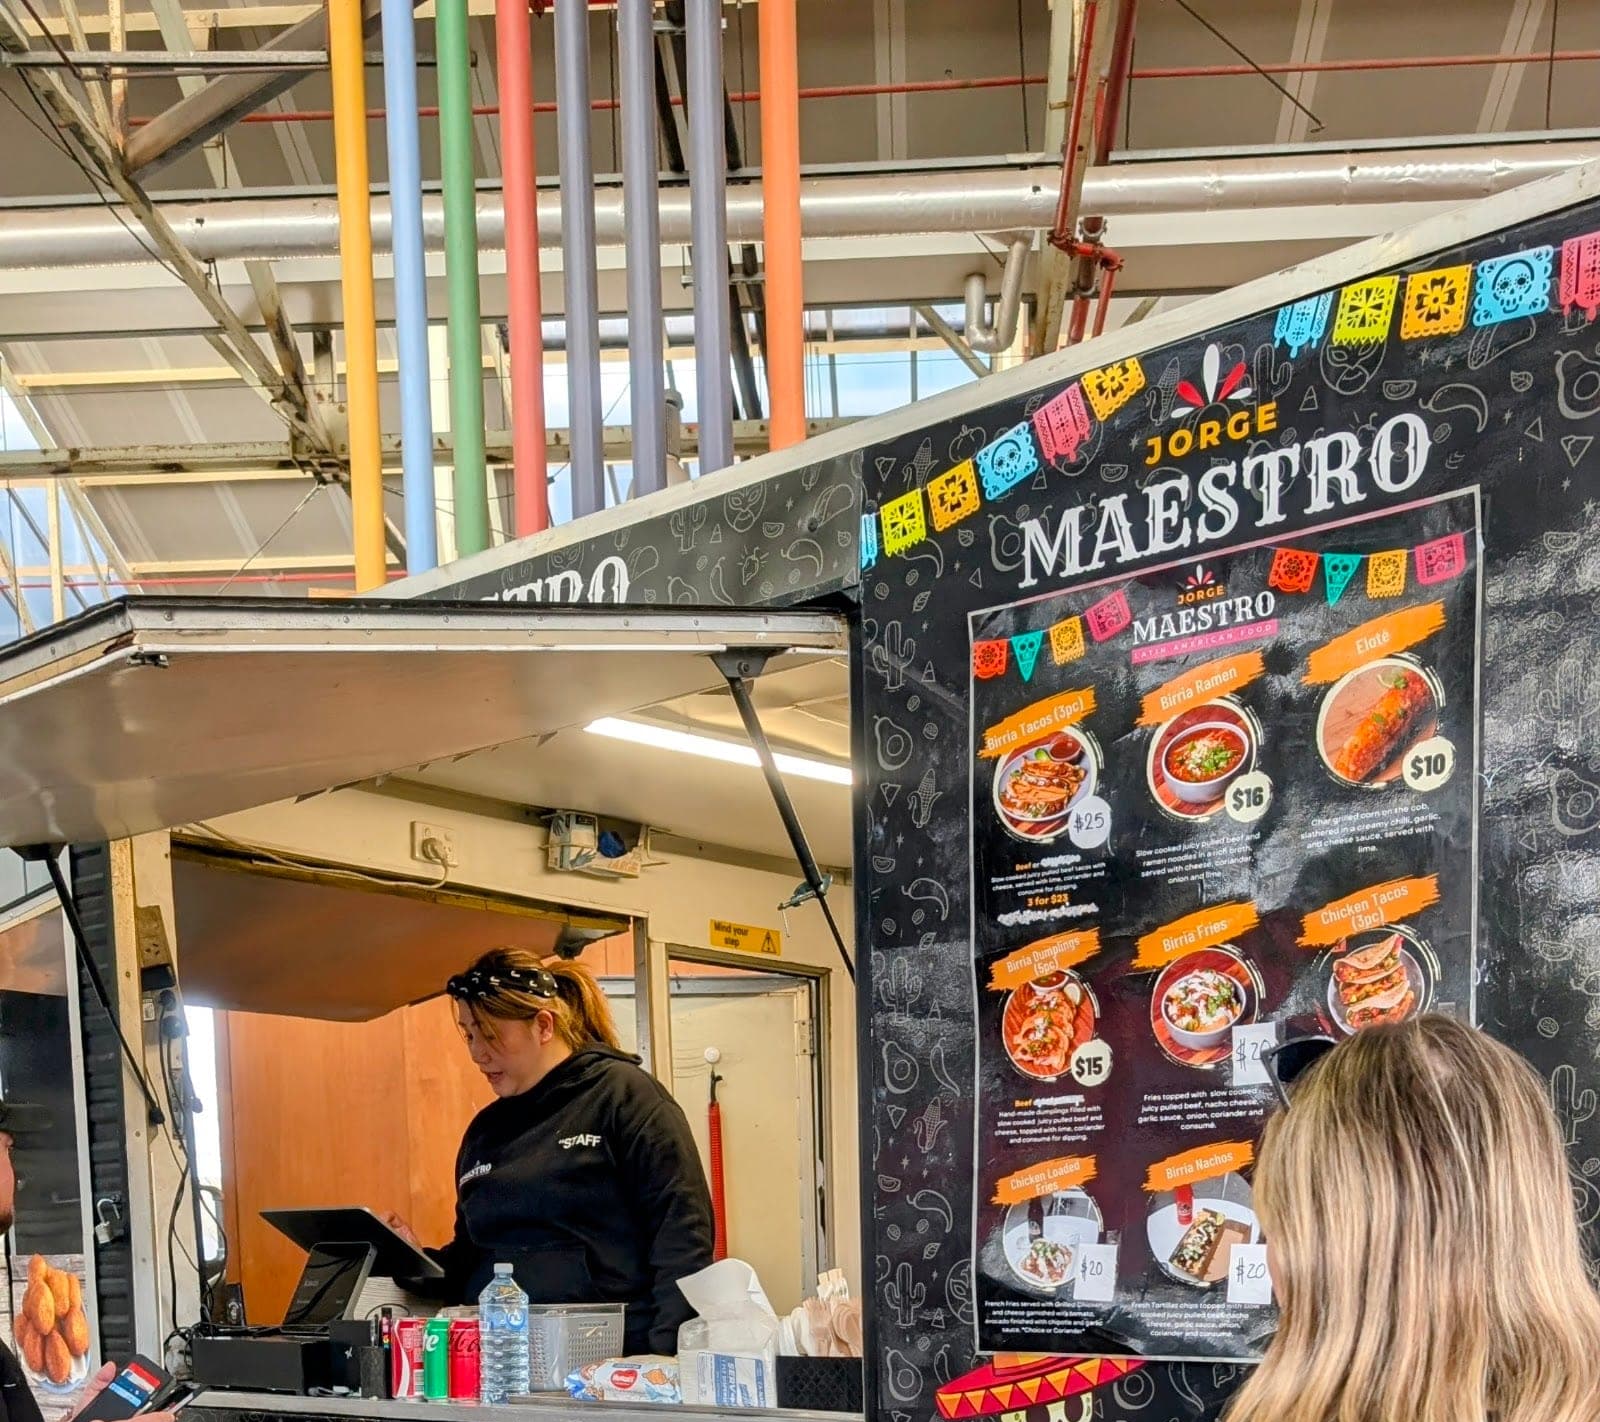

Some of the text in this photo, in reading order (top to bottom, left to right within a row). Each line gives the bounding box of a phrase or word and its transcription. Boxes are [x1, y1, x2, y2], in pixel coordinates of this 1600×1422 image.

[1144, 401, 1278, 465] JORGE
[1019, 413, 1432, 588] MAESTRO
[1177, 585, 1225, 605] JORGE
[1132, 591, 1275, 645] MAESTRO
[1173, 631, 1233, 652] AMERICAN
[1240, 623, 1272, 637] FOOD
[1160, 667, 1238, 711] Birria Ramen
[987, 697, 1085, 750] Birria Tacos (3pc)
[1411, 752, 1446, 781] $10
[1232, 786, 1264, 811] $16
[1073, 812, 1105, 833] $25
[1035, 897, 1050, 905] for
[1320, 885, 1409, 925] Chicken Tacos
[714, 920, 749, 936] Mind your
[1351, 907, 1385, 931] (3pc)
[724, 936, 740, 948] step
[1162, 918, 1228, 953] Birria Fries
[1006, 936, 1081, 974] Birria Dumplings
[1075, 1056, 1103, 1078] $15
[1014, 1099, 1033, 1107] Beef
[1010, 1161, 1081, 1190] Chicken Loaded
[1166, 1151, 1234, 1180] Birria Nachos
[1035, 1182, 1059, 1195] Fries
[1081, 1254, 1103, 1281] $20
[1236, 1257, 1266, 1285] $20
